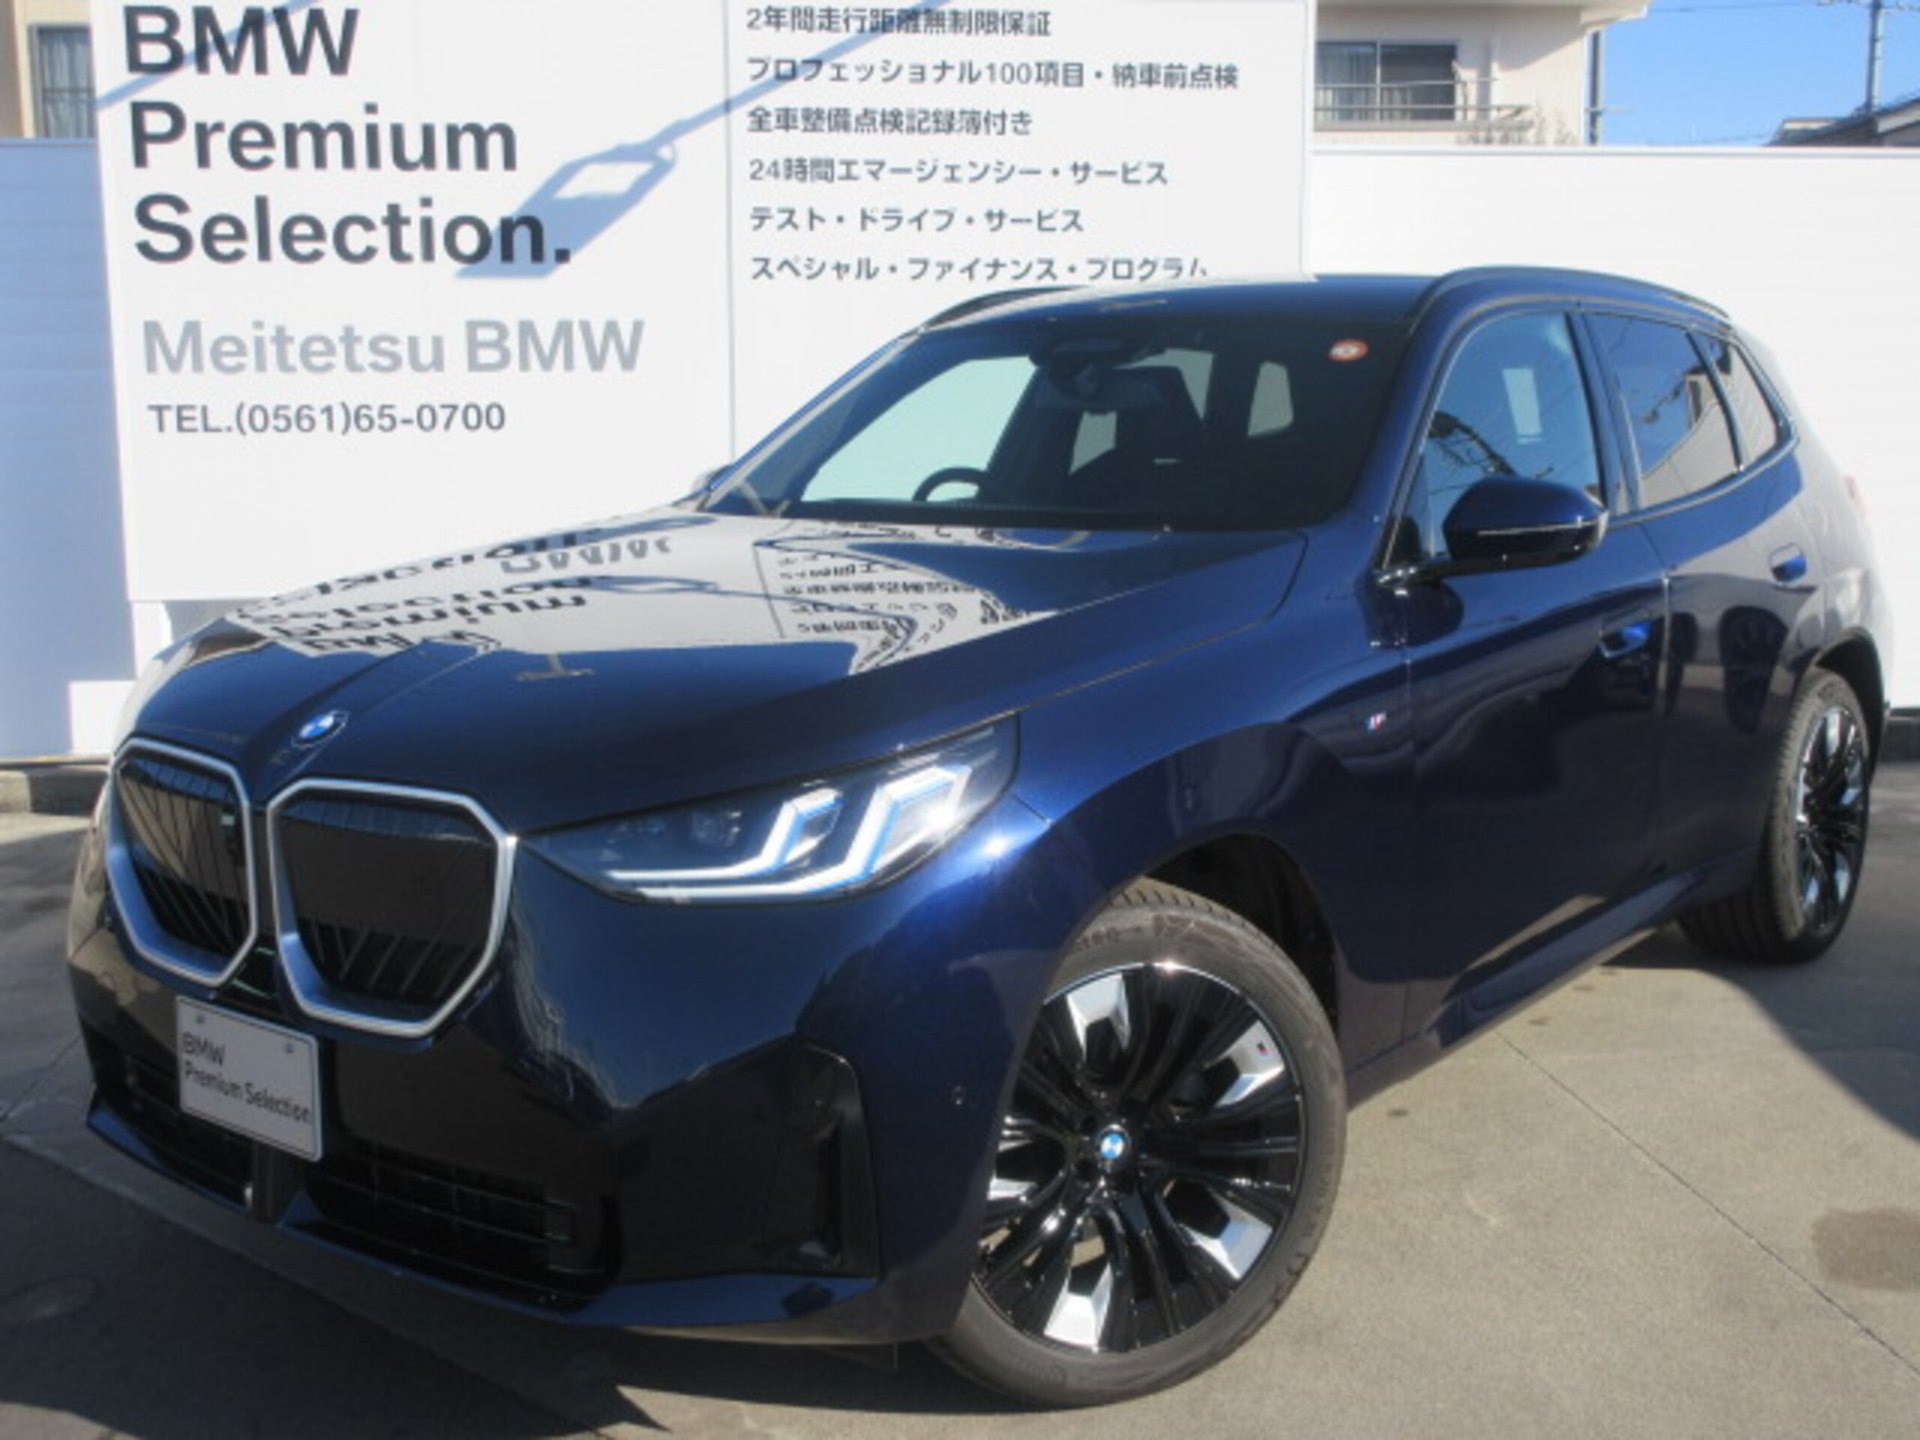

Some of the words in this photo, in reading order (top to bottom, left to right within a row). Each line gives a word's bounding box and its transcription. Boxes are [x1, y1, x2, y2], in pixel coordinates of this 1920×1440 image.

[747, 5, 1051, 37] 2年間走行距離無制限保証
[123, 4, 359, 77] BMW
[747, 57, 1239, 90] プロフェッショナル100項目・納車前点検
[130, 100, 517, 172] Premium
[748, 106, 1032, 136] 全車整備点検記録簿付き
[749, 157, 1168, 185] 24時間エマージェンシー・サービス
[135, 193, 572, 266] Selection.
[750, 206, 1084, 233] テスト・ドライブ・サービス
[144, 320, 445, 374] Meitetsu
[465, 320, 645, 373] BMW
[148, 402, 506, 436] TEL.(0561)65-0700
[182, 1032, 226, 1067] BMW
[184, 1058, 244, 1100] Premium
[244, 1081, 312, 1124] Selection
